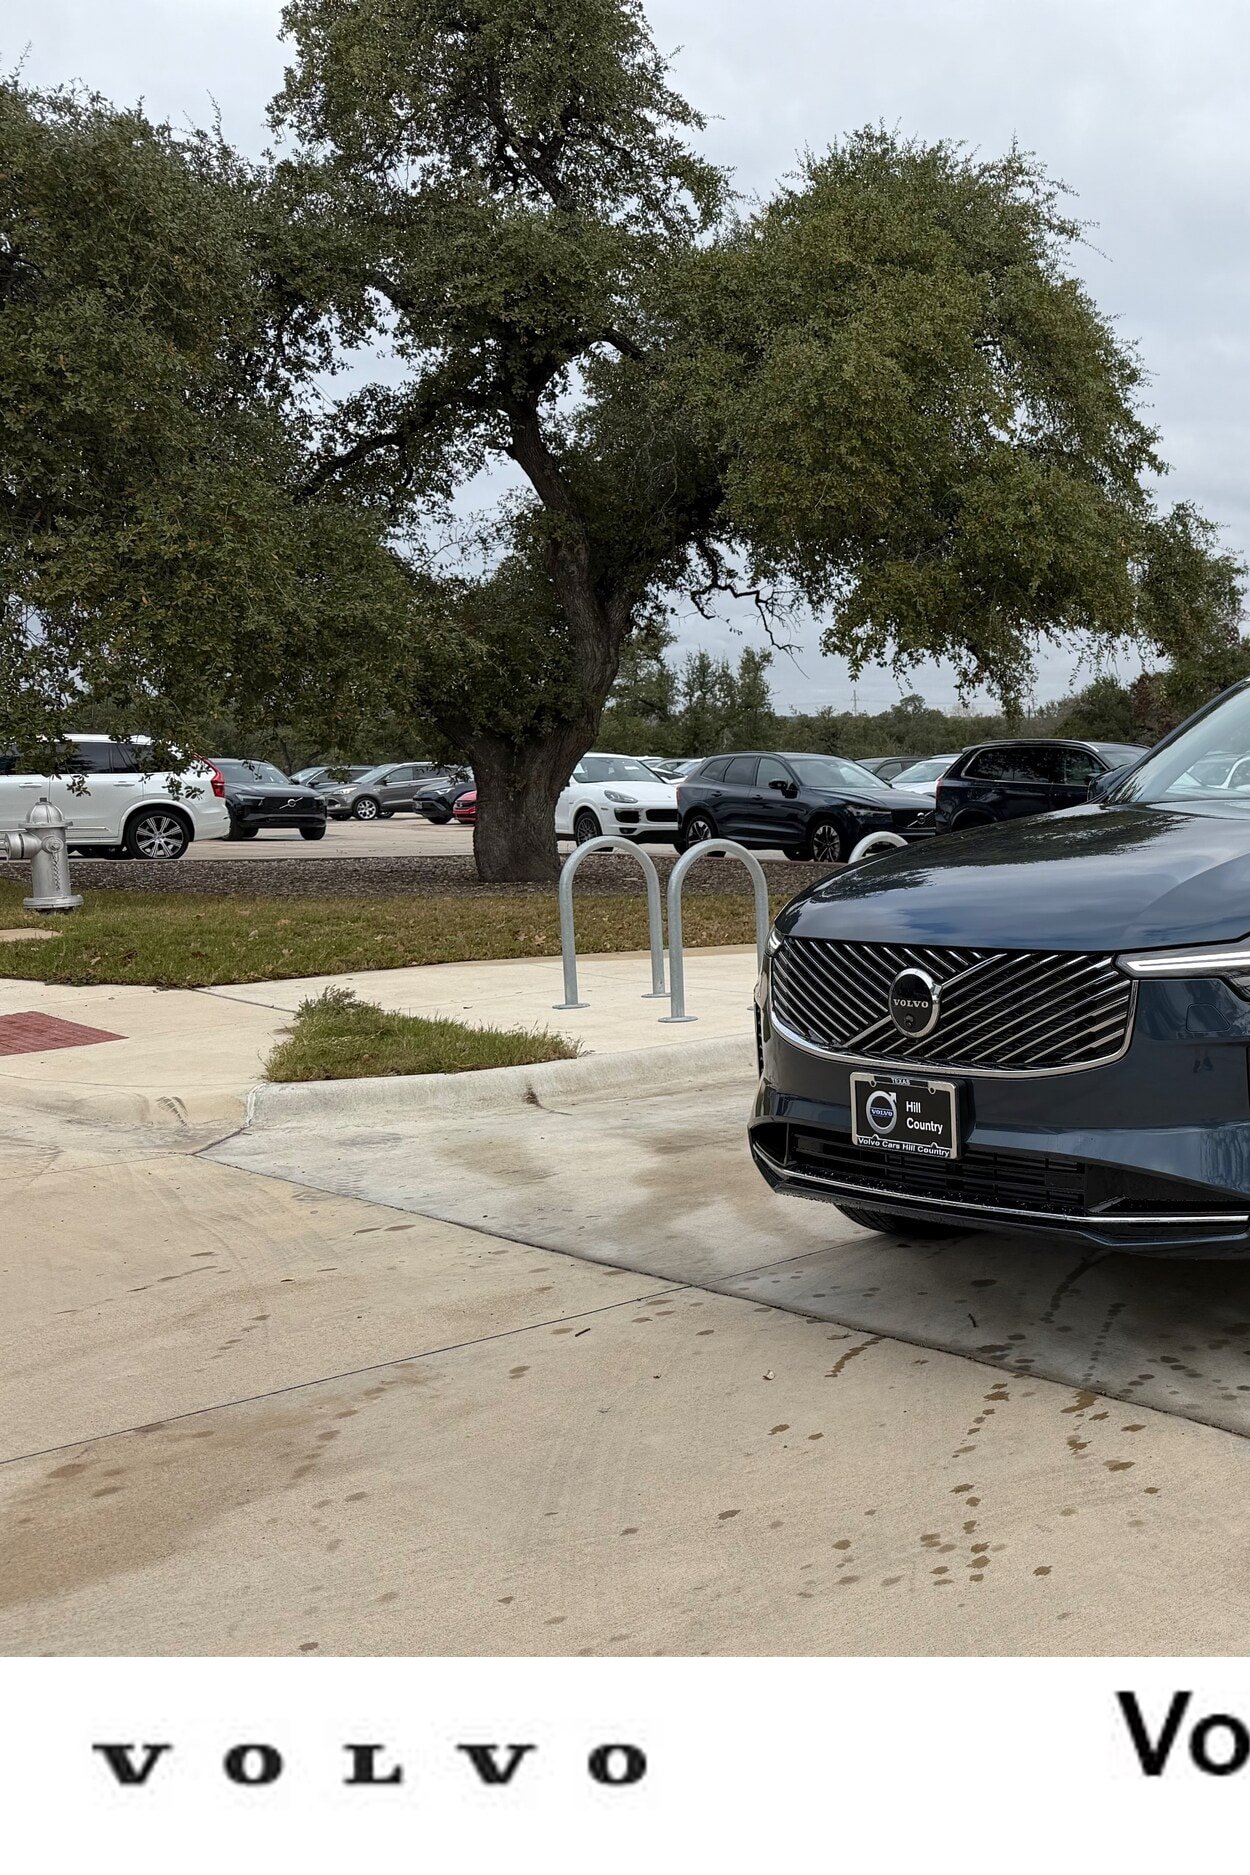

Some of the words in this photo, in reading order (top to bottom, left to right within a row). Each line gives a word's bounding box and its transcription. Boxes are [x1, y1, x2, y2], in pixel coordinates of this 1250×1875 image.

[893, 998, 929, 1009] VOLVO
[871, 1108, 893, 1117] VOLVO
[905, 1100, 921, 1113] Hill
[906, 1117, 943, 1134] Country
[858, 1137, 880, 1146] Volvo
[882, 1141, 900, 1150] Cars
[902, 1143, 916, 1152] Hill
[917, 1145, 950, 1158] Country
